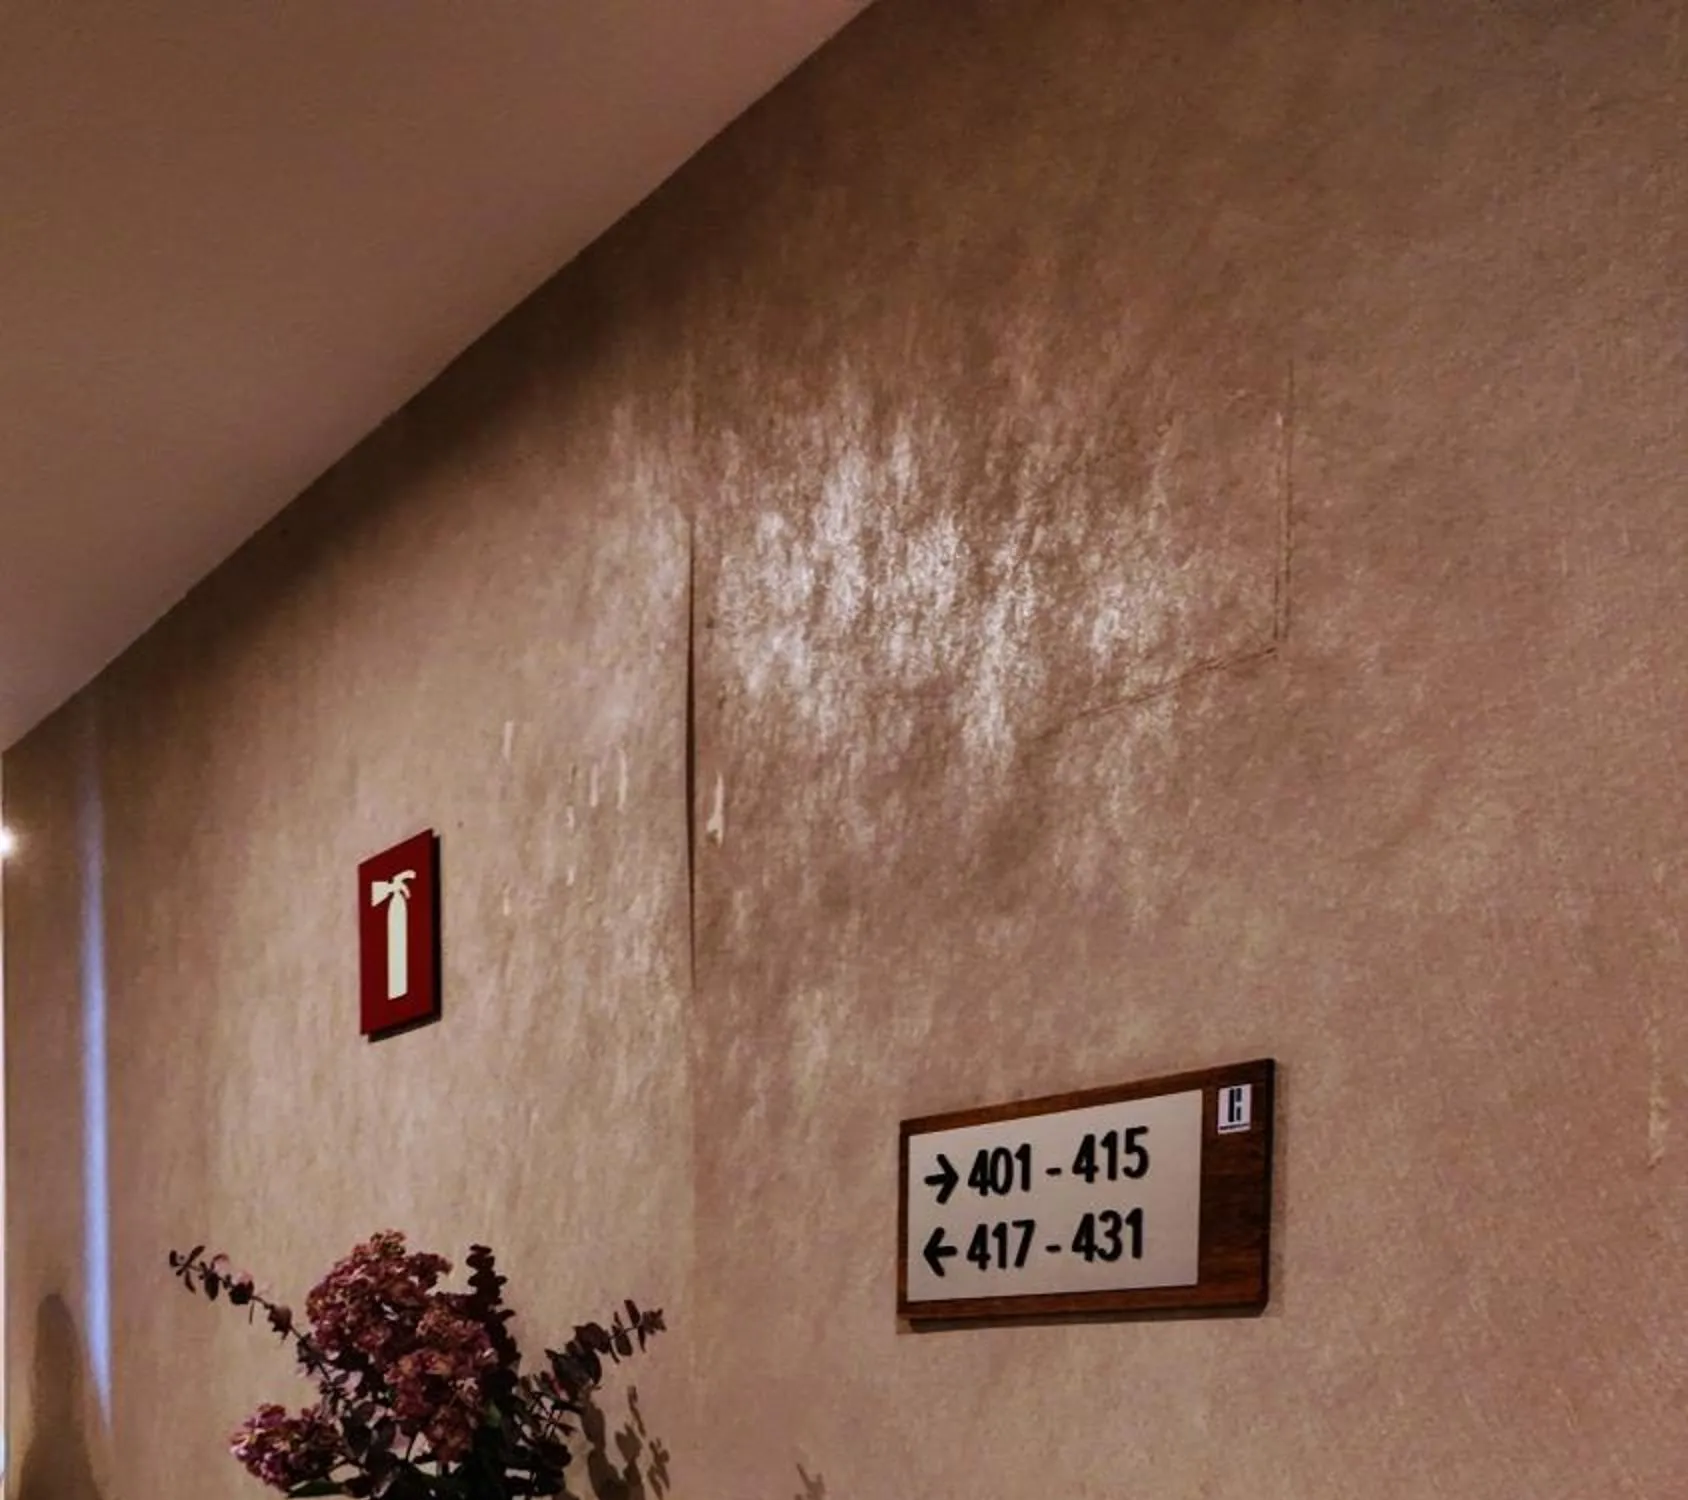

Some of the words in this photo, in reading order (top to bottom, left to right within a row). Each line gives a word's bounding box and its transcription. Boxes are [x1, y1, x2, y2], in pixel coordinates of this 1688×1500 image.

[967, 1143, 1032, 1196] 401
[1071, 1125, 1150, 1184] 415
[965, 1218, 1036, 1272] 417
[1071, 1207, 1144, 1264] 431
